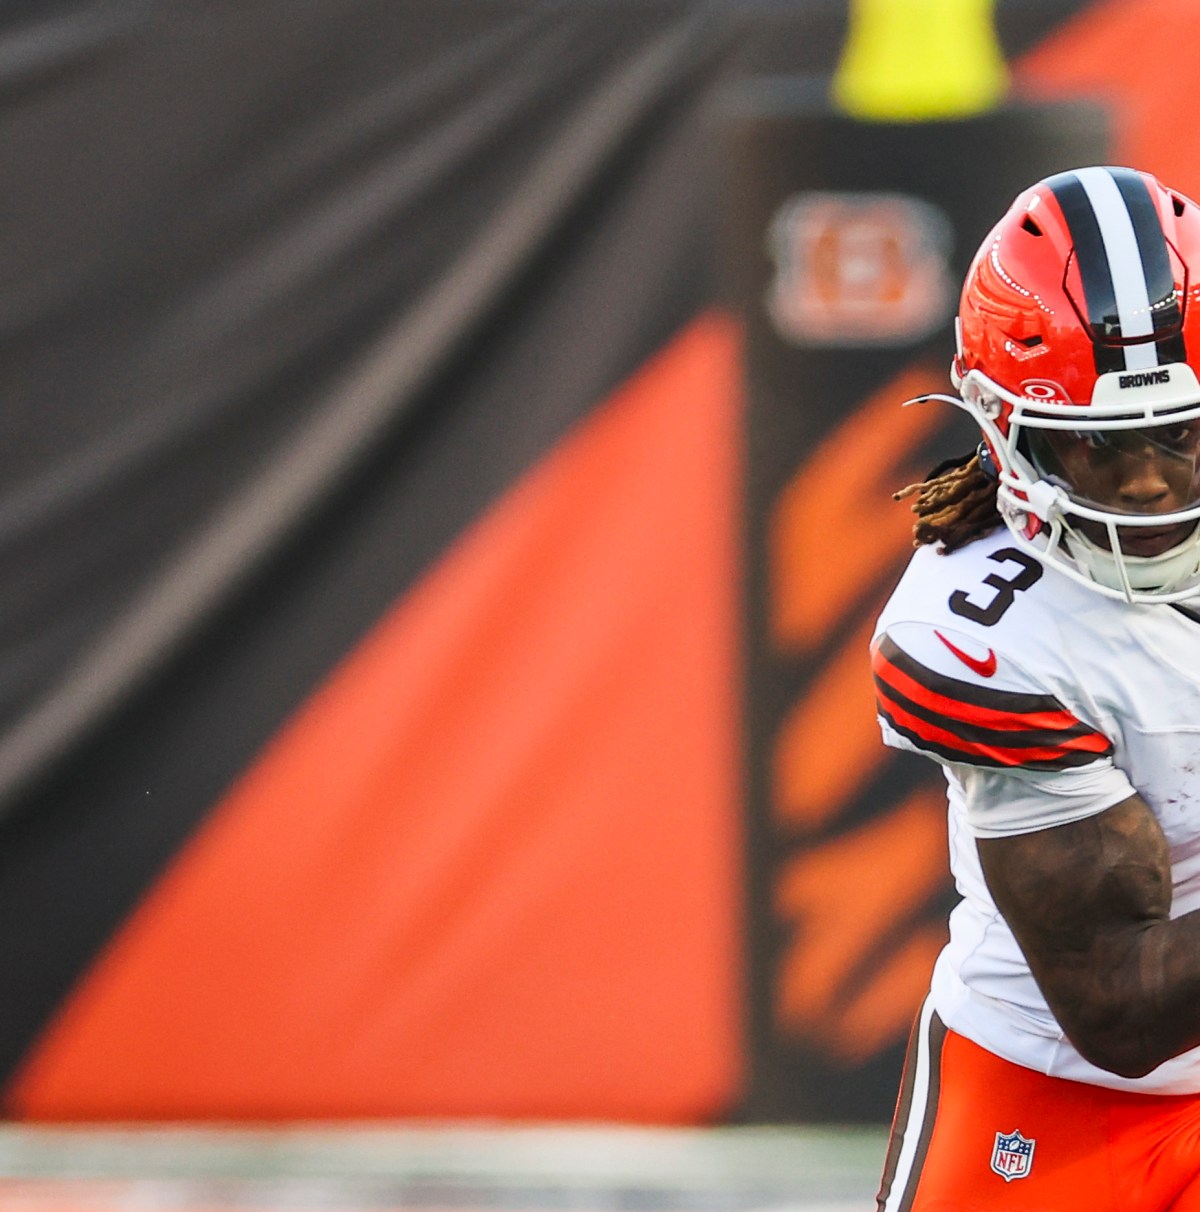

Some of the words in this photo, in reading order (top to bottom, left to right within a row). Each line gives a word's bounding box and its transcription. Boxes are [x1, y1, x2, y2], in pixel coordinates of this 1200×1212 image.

[1119, 369, 1170, 389] BROWNS
[948, 547, 1043, 627] 3
[997, 1151, 1024, 1172] NFL
